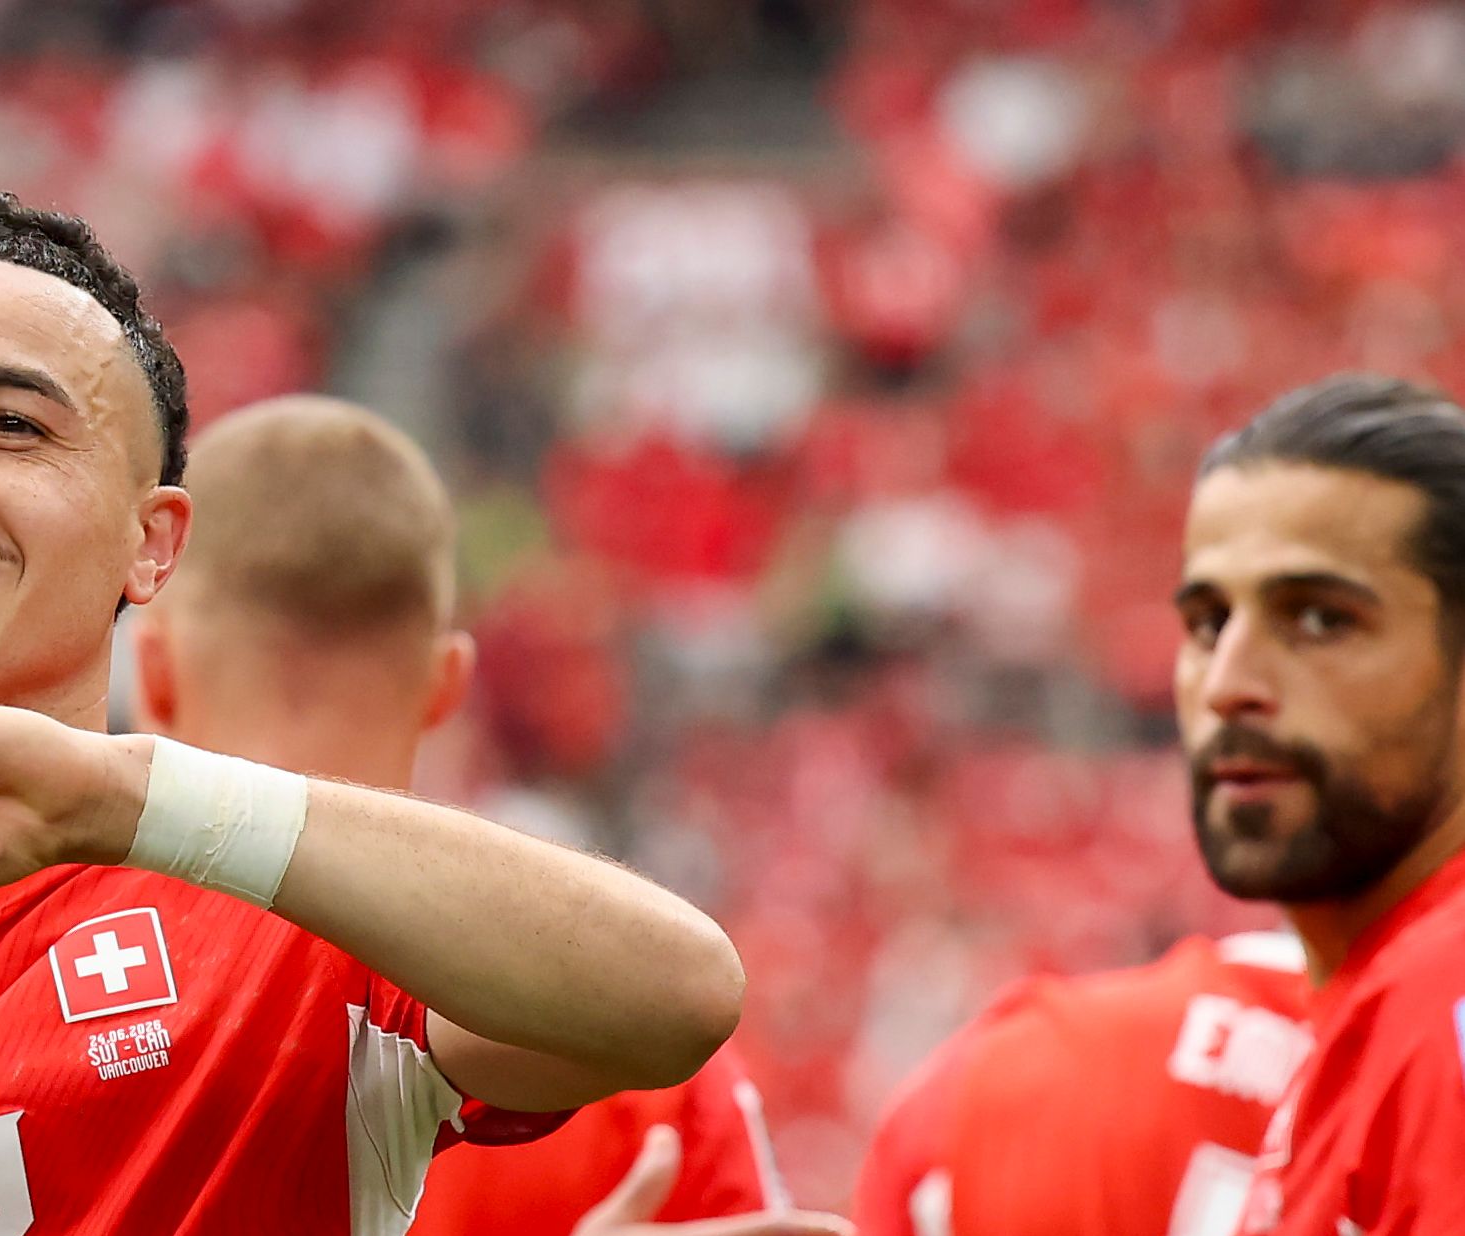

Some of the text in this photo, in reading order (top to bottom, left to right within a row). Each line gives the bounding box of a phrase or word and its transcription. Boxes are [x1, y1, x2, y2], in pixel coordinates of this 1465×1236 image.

[87, 1042, 119, 1066] SUI
[134, 1028, 172, 1054] CAN
[89, 1019, 162, 1048] 24.06.2026
[98, 1050, 169, 1081] VANCOUVER
